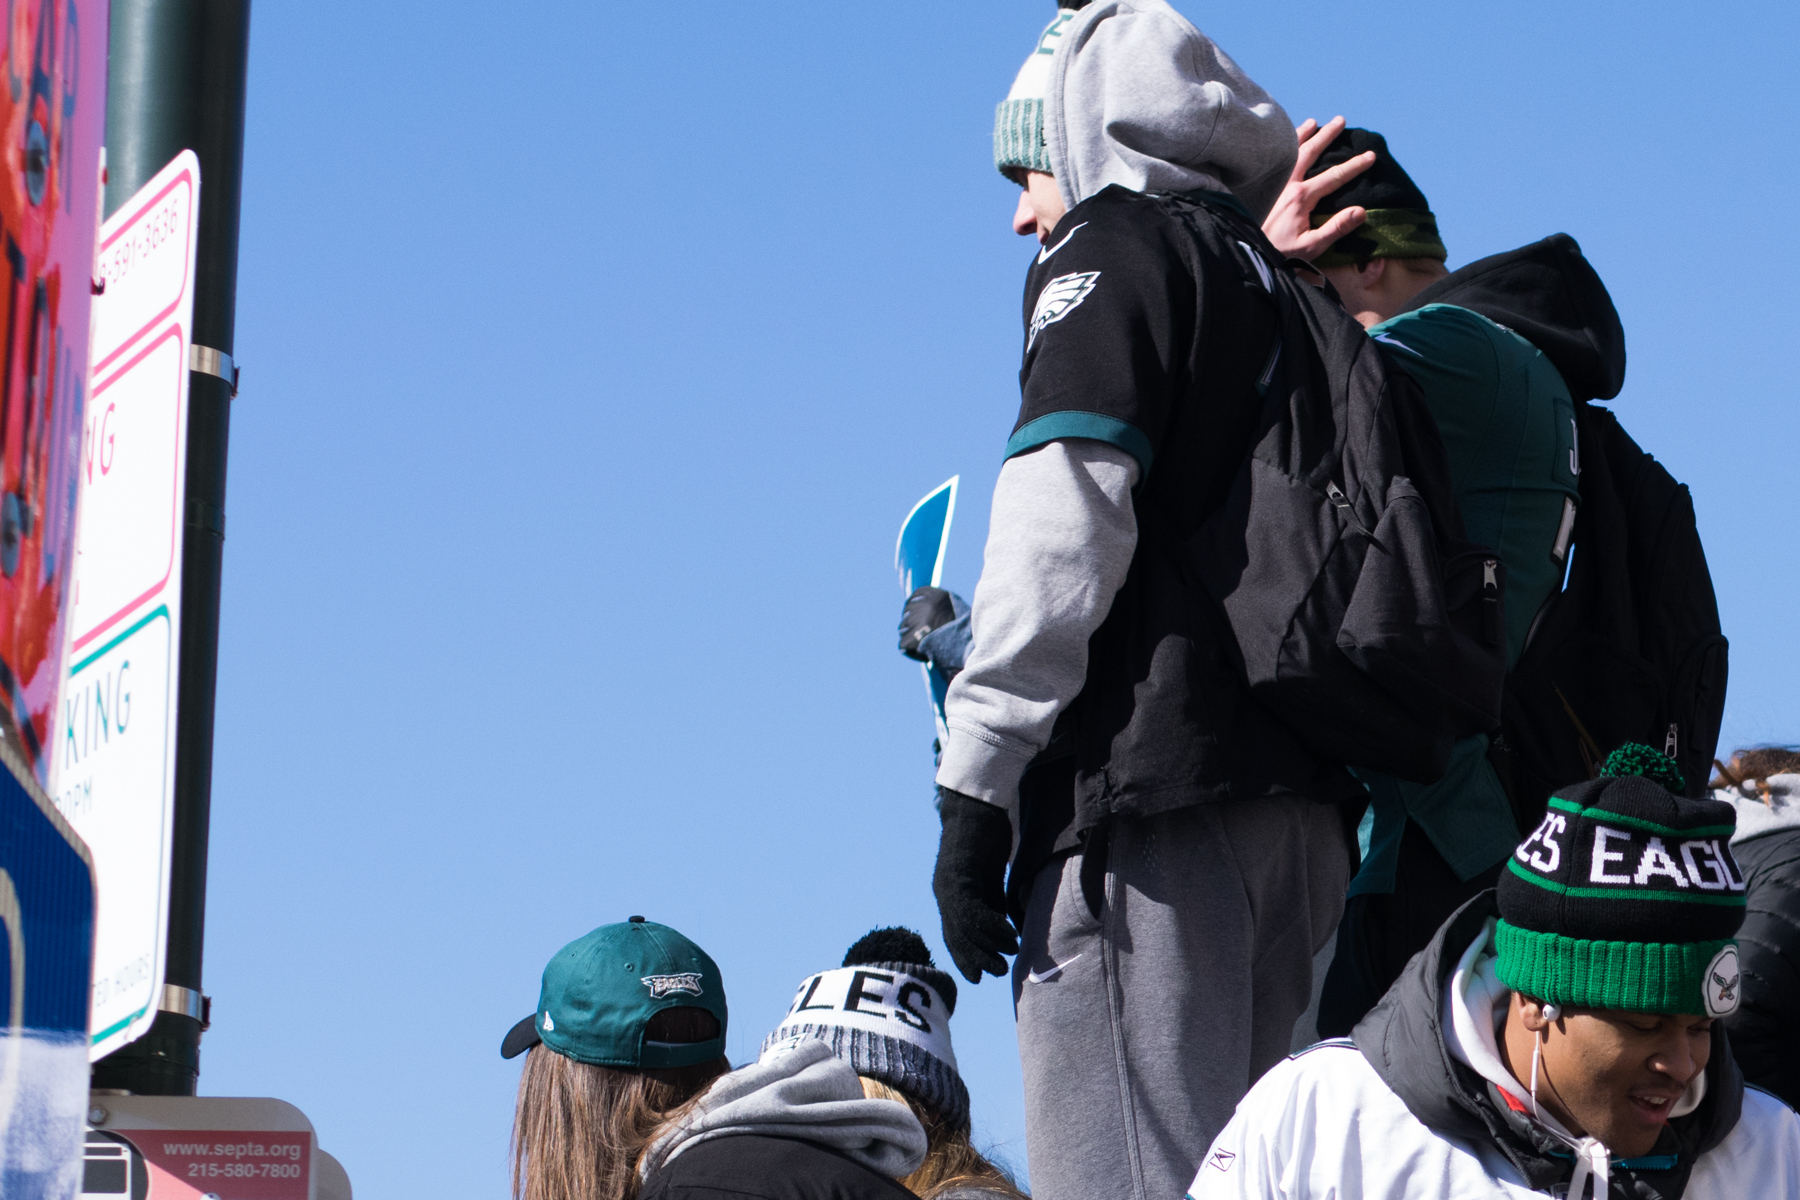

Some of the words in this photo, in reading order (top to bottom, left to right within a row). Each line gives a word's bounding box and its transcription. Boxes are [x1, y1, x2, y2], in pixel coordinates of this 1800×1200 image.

[65, 658, 131, 771] KING
[789, 970, 933, 1034] LES
[163, 1142, 301, 1160] www.septa.org
[188, 1163, 301, 1178] 215-580-7800
